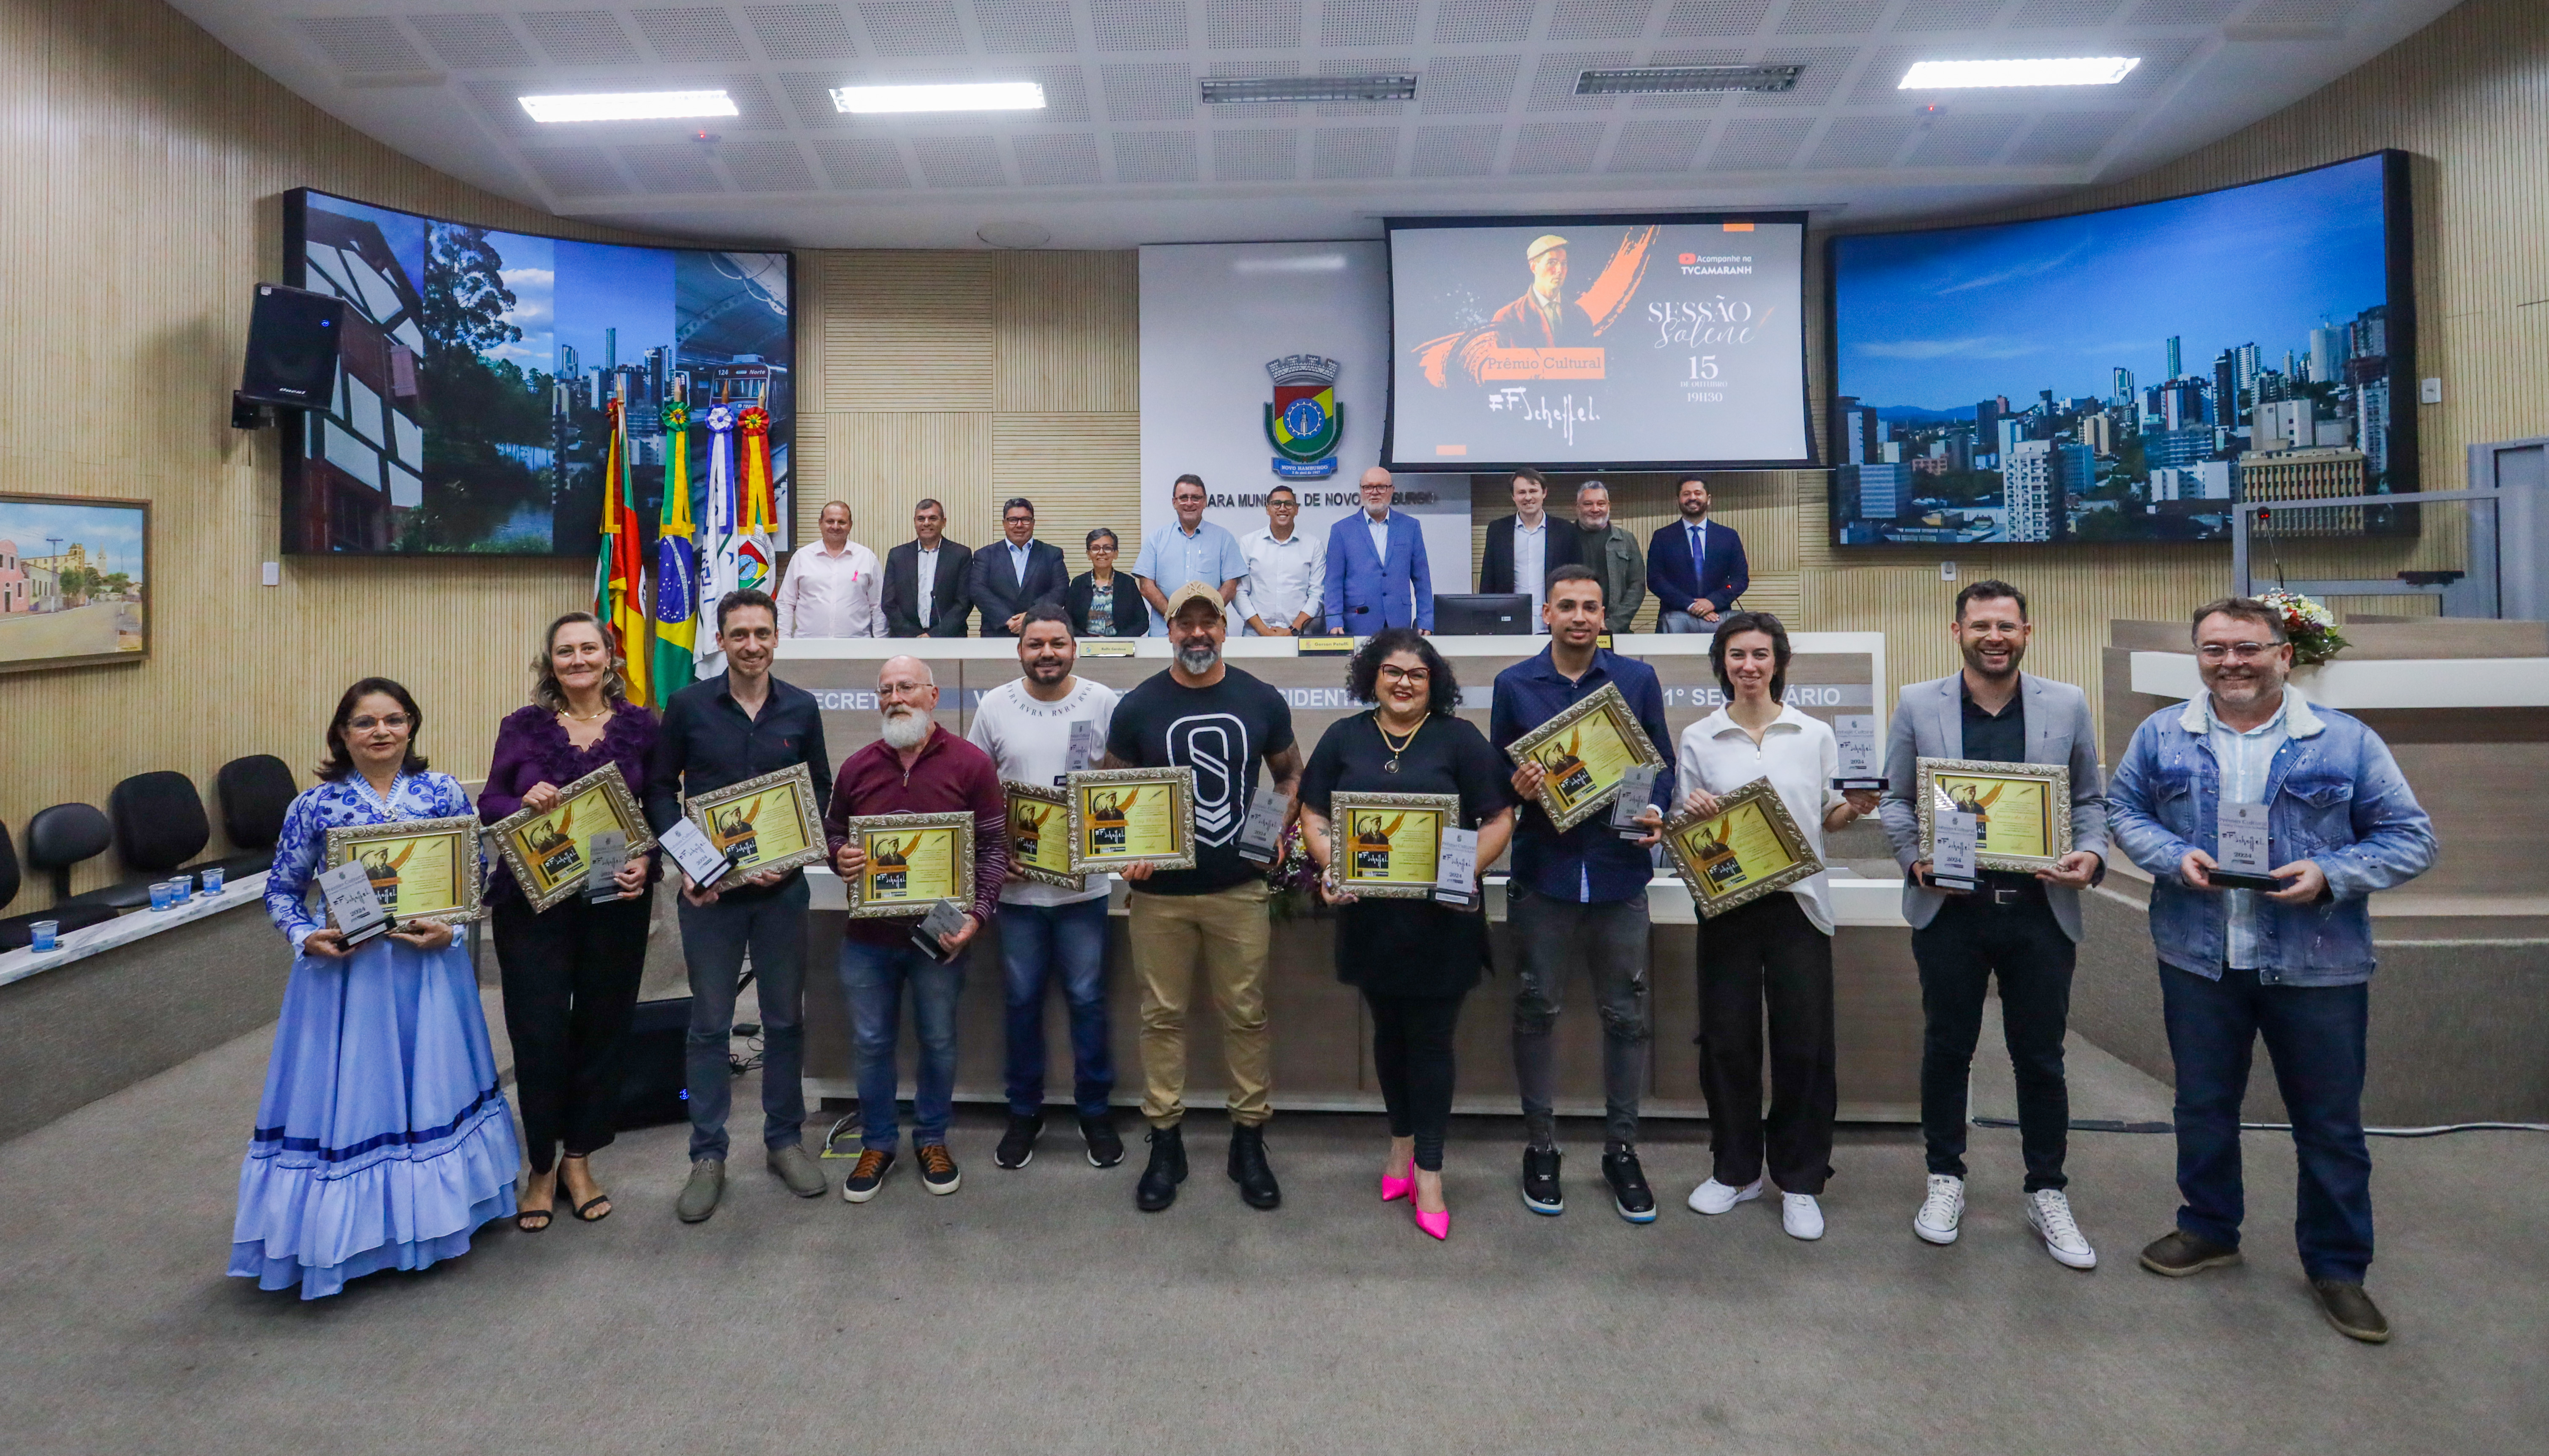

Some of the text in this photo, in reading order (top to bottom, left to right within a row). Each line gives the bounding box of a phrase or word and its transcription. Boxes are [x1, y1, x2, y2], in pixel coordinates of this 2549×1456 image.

[1697, 255, 1740, 263] Acompanhe
[1681, 266, 1752, 275] TVCAMARANH
[1648, 294, 1751, 322] SESSÃO
[1654, 314, 1755, 349] Solene
[1487, 357, 1601, 369] Prêmio Cultural
[1688, 355, 1718, 380] 15
[1687, 392, 1723, 402] 19H30
[1206, 494, 1235, 507] ARA
[1304, 493, 1320, 507] DE
[1325, 492, 1361, 506] NOVO
[1006, 684, 1018, 704] RVRA
[1078, 683, 1094, 702] RVRA
[1019, 703, 1042, 717] RVRA
[1052, 703, 1076, 717] RVRA
